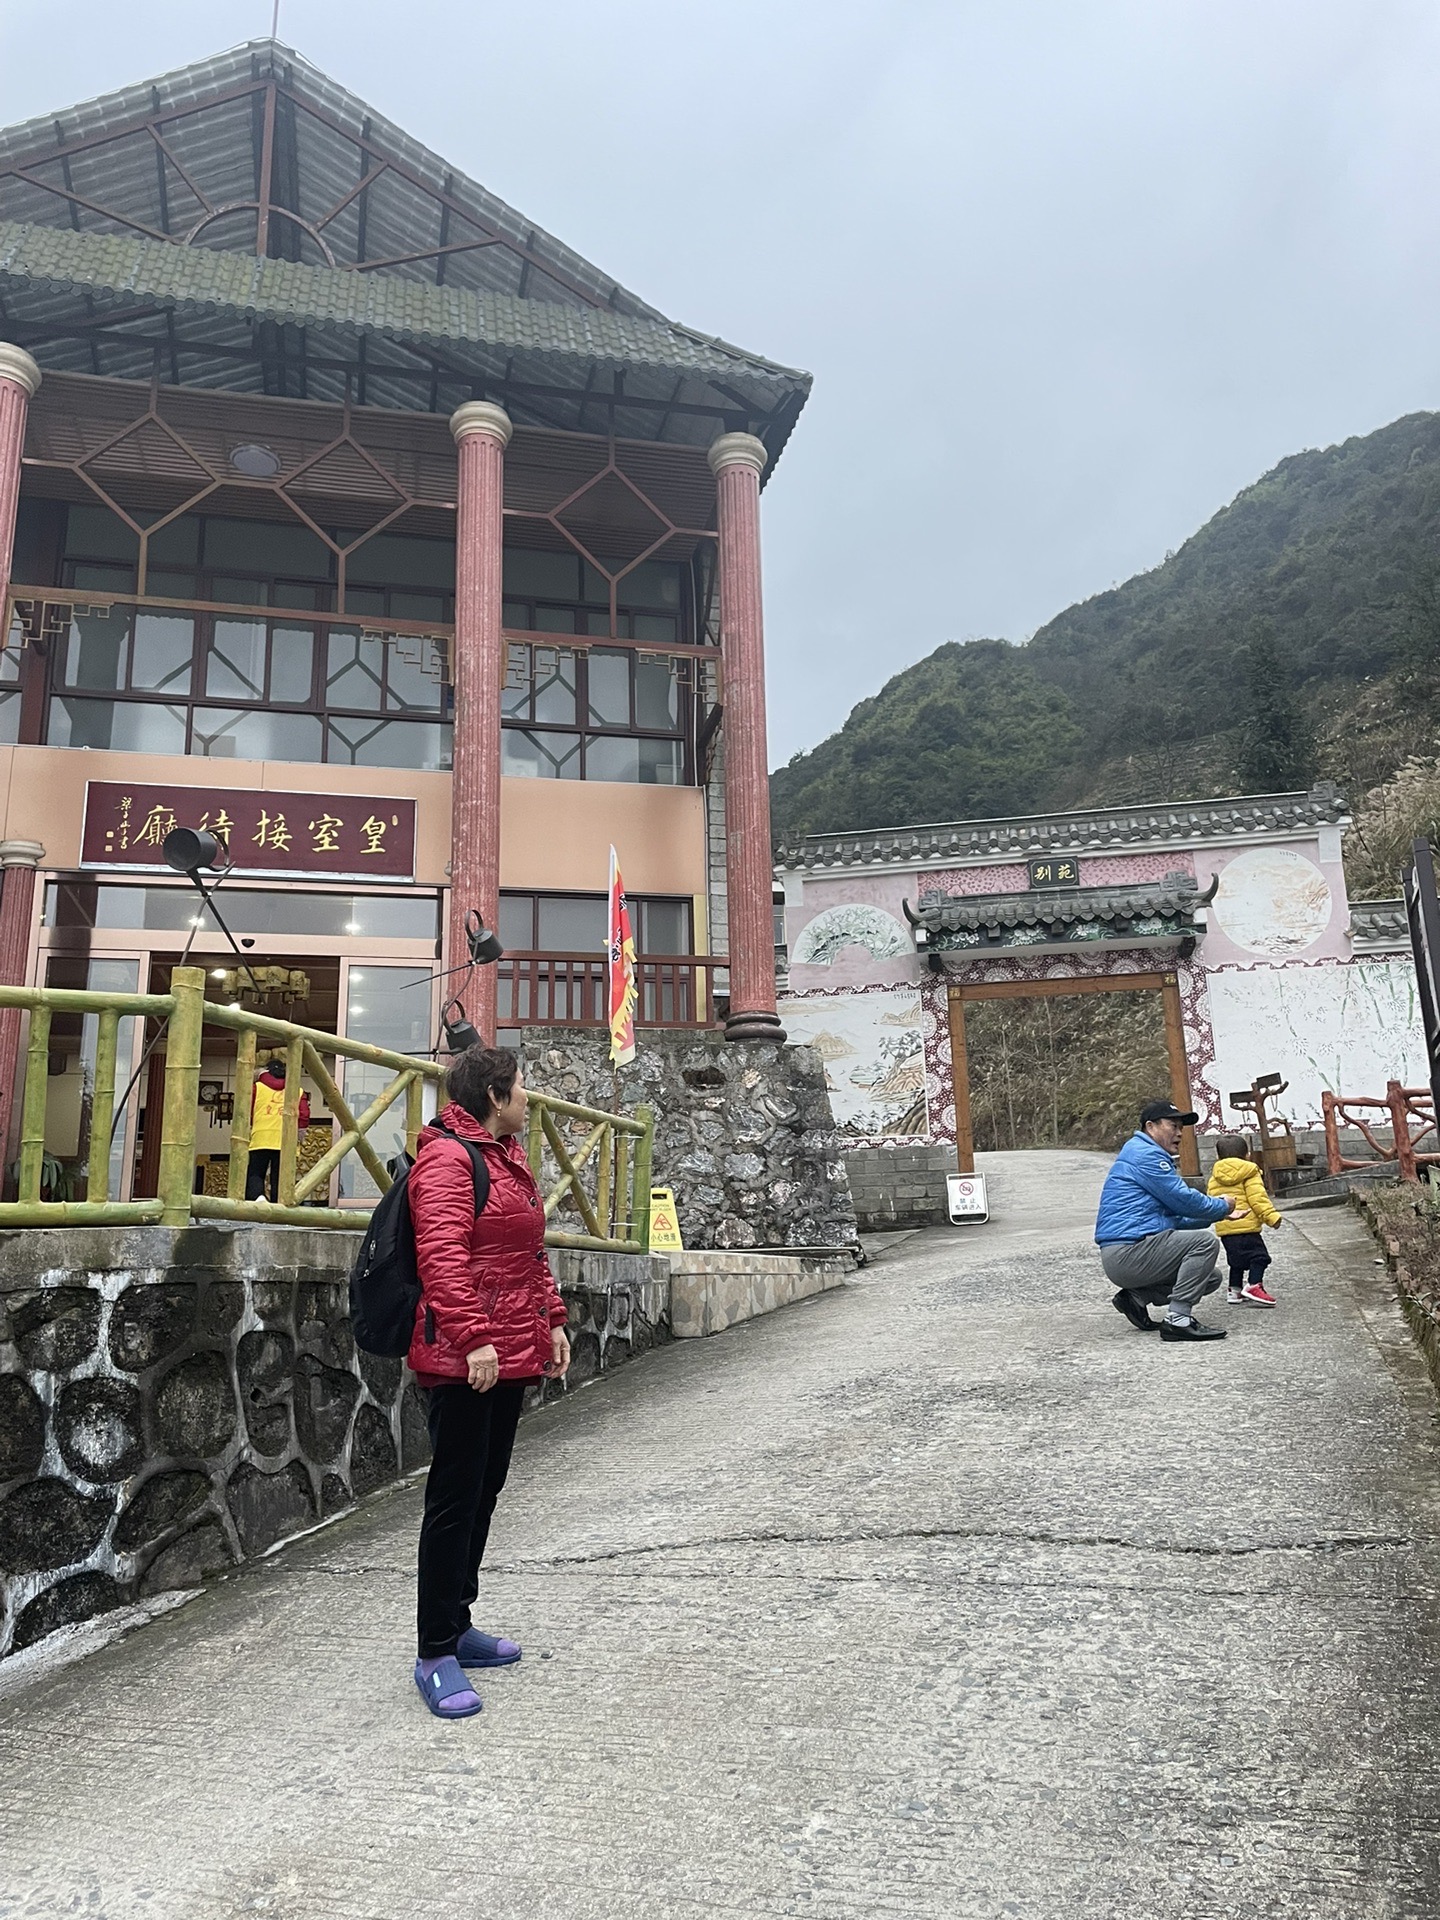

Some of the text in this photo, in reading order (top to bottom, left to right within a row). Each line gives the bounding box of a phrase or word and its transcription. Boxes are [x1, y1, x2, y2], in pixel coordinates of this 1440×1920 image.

[1034, 864, 1075, 881] 别苑
[651, 1233, 676, 1242] 小心地滑
